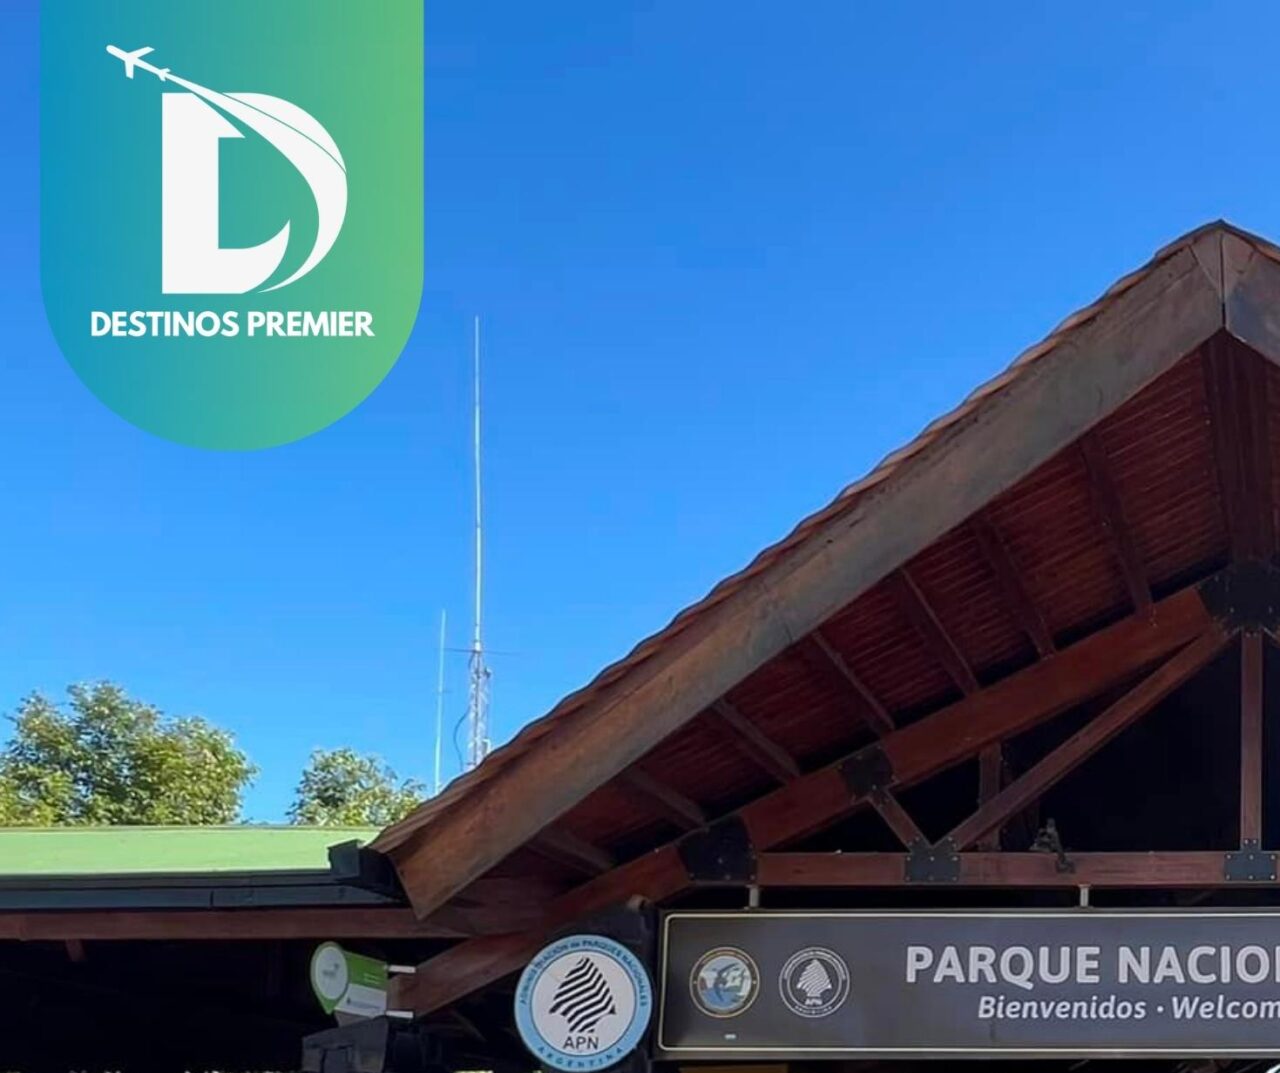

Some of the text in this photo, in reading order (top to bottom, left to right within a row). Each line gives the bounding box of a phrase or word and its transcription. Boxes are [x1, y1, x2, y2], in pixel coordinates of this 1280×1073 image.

[905, 945, 1100, 990] PARQUE
[977, 994, 1147, 1019] Bienvenidos
[562, 1036, 599, 1051] APN
[538, 1046, 623, 1068] ARGENTINA
